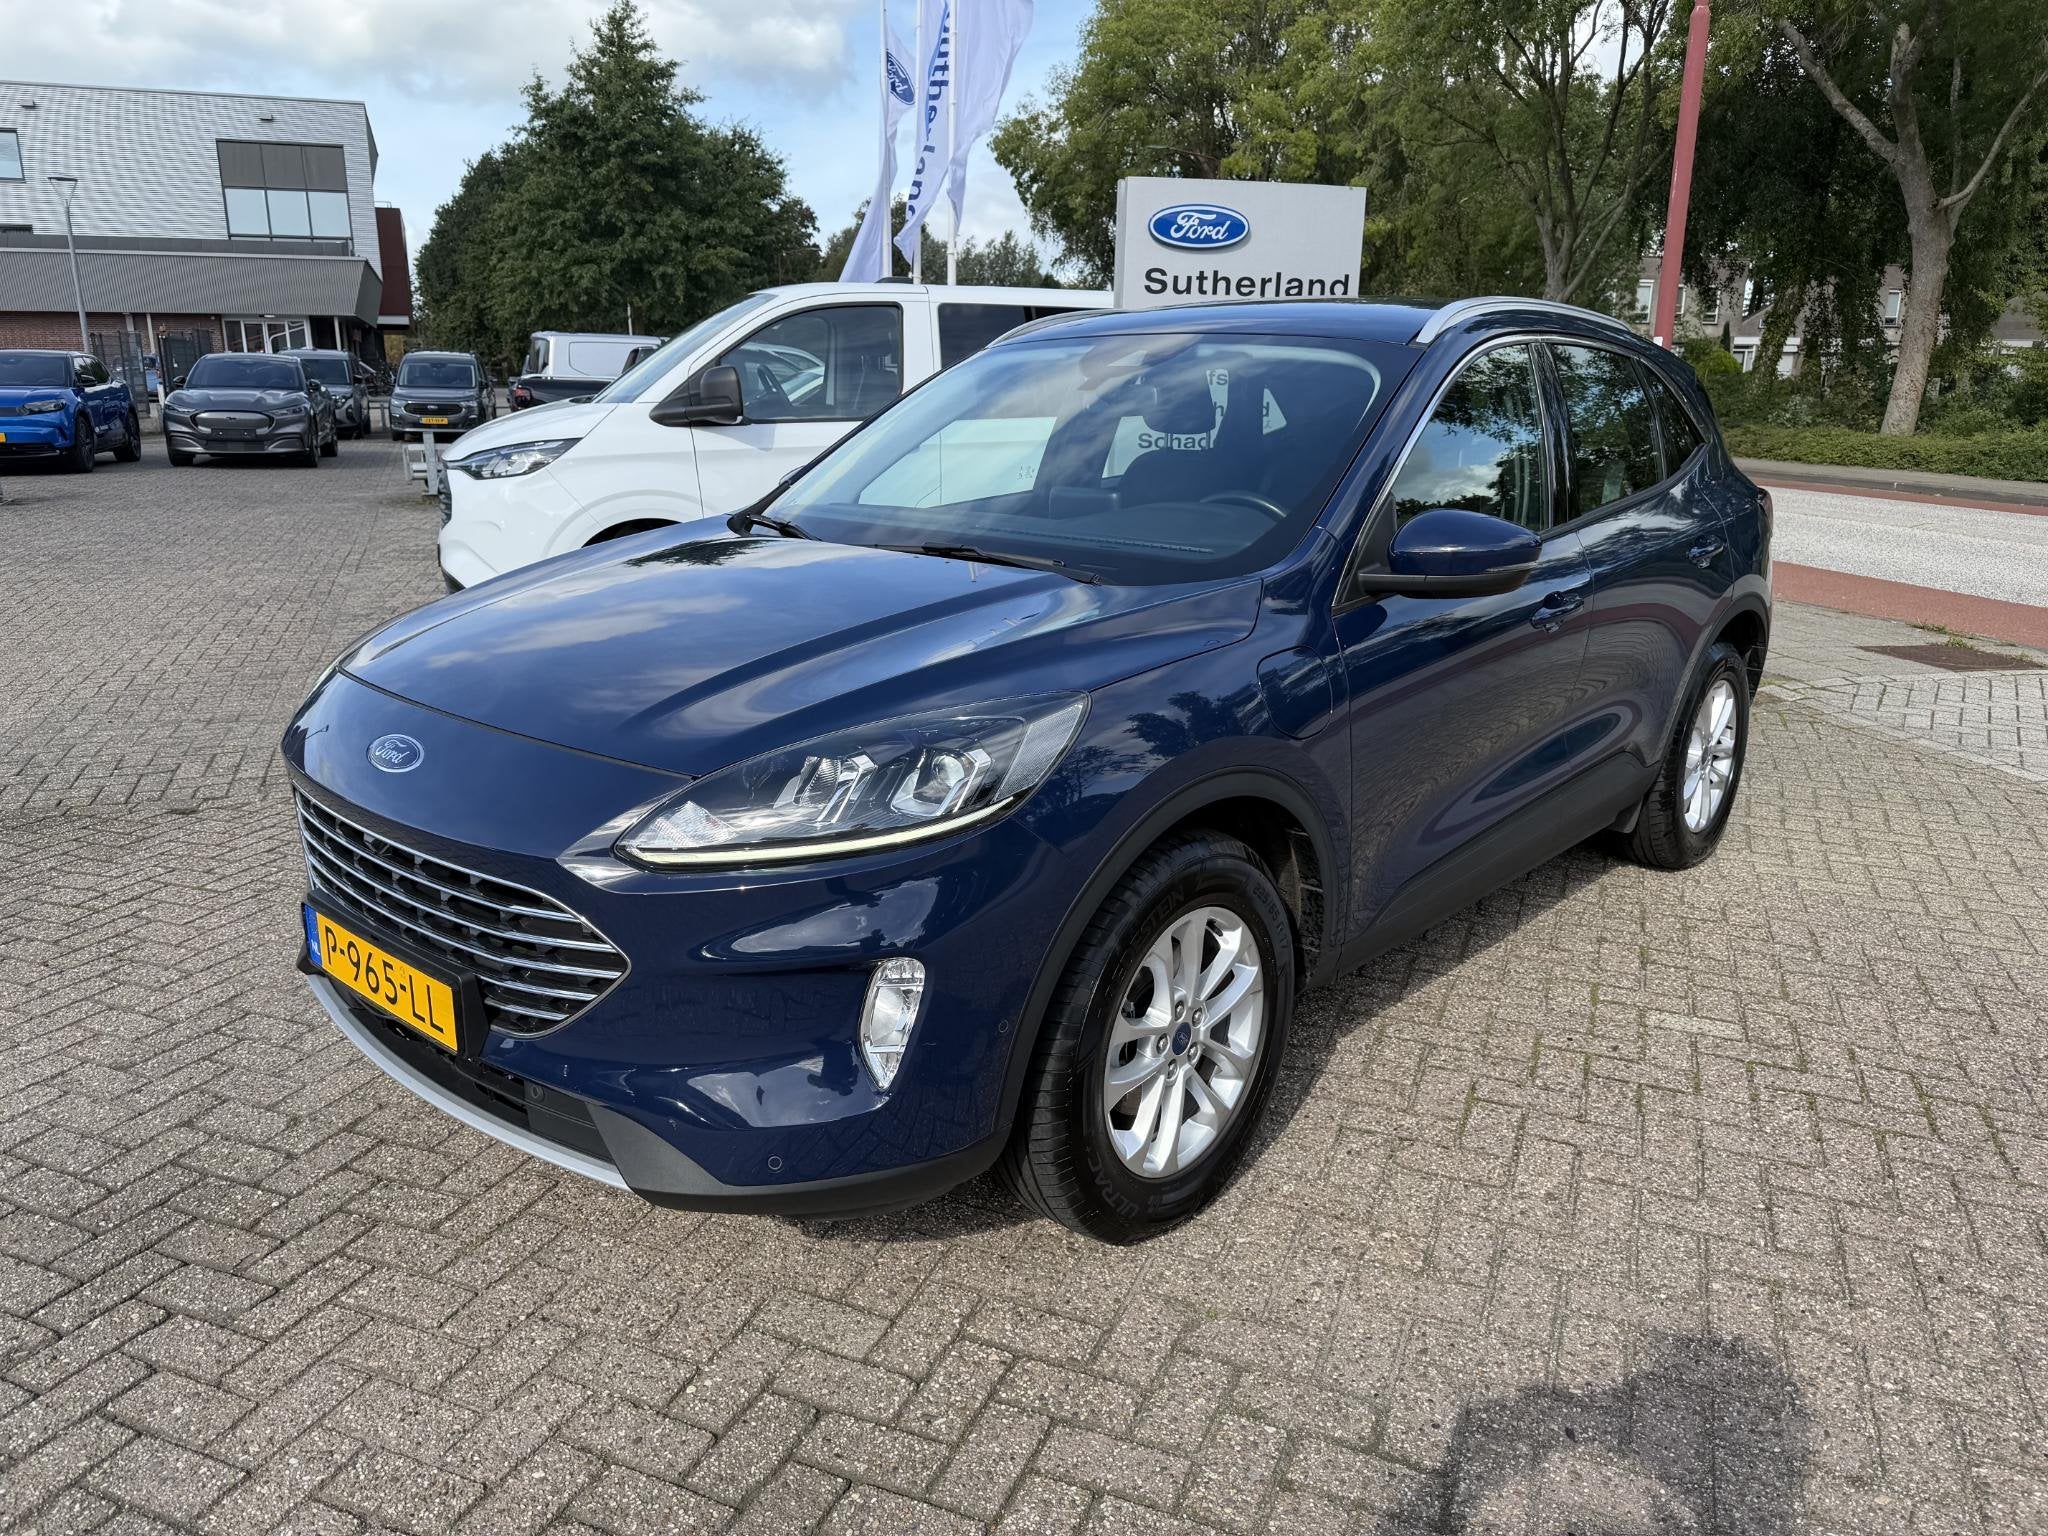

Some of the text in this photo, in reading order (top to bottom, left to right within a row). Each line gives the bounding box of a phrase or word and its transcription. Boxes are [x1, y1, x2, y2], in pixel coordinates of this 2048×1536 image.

[1170, 211, 1231, 240] Ford
[1144, 267, 1351, 298] Sutherland
[375, 739, 410, 764] Ford
[324, 924, 445, 1034] P-965-LL
